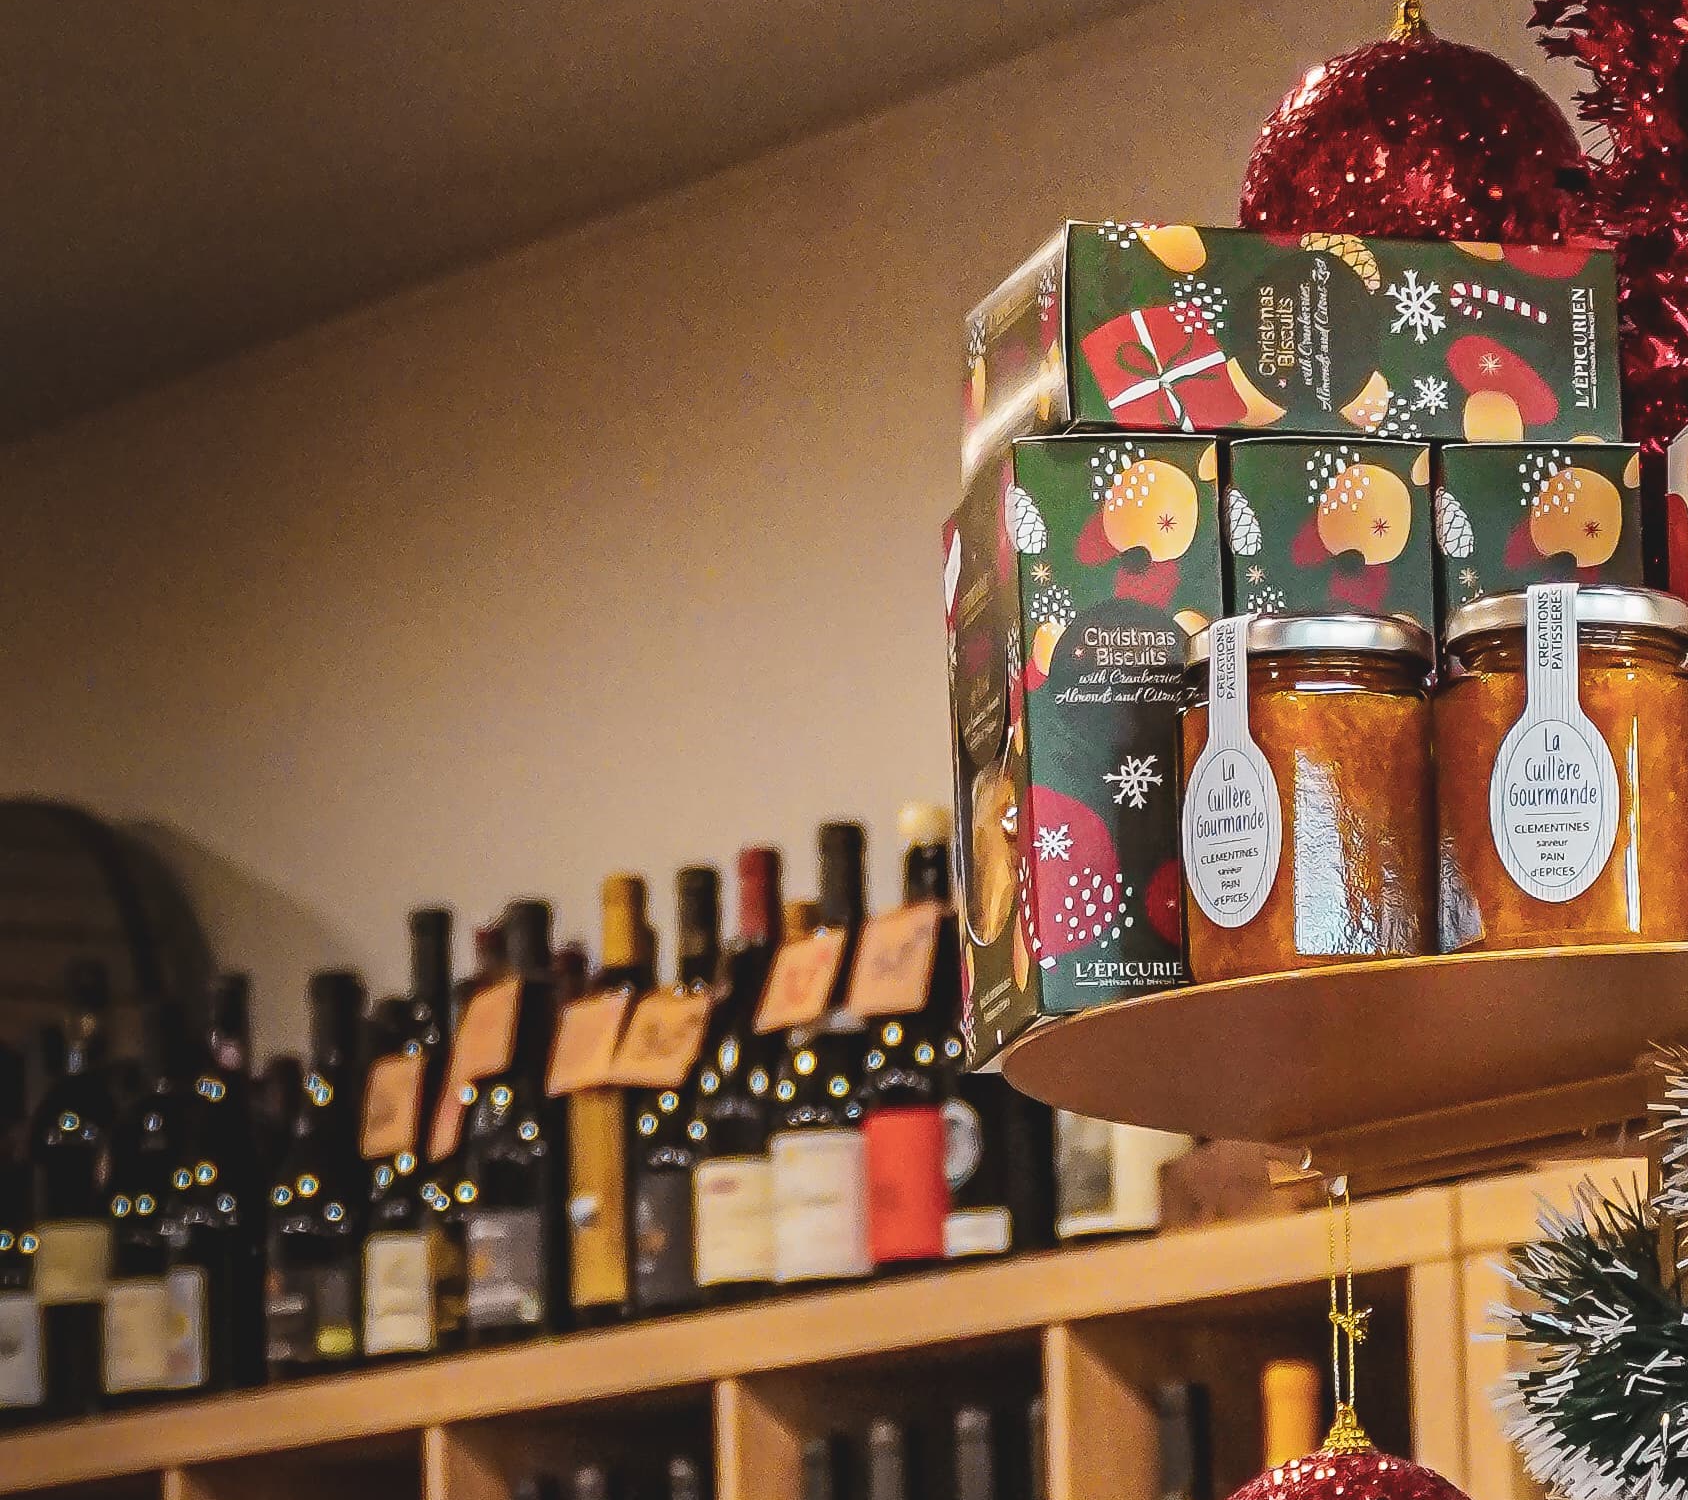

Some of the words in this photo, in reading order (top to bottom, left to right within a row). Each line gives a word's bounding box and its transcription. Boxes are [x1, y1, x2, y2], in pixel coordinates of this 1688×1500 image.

[1258, 286, 1276, 376] Christmas
[1276, 297, 1295, 368] Biscuits
[1572, 288, 1590, 409] L'ÉPICURIEN
[1084, 626, 1177, 647] Christmas
[1538, 591, 1549, 668] CREATIONS
[1551, 589, 1563, 670] PATISSIERES
[1097, 648, 1169, 667] Biscuits
[1216, 624, 1227, 699] CREATIONS
[1079, 671, 1107, 685] with
[1113, 687, 1143, 704] and
[1544, 727, 1561, 753] La
[1221, 757, 1236, 782] La
[1524, 756, 1581, 783] Cuillère
[1207, 788, 1252, 813] Cuillère
[1509, 783, 1598, 808] Gourmande
[1196, 810, 1265, 839] Gourmande
[1514, 821, 1590, 835] CLEMENTINES
[1200, 846, 1260, 865] CLEMENTINES
[1540, 852, 1565, 863] PAIN
[1221, 878, 1241, 891] PAIN
[1530, 867, 1576, 878] d'EPICES
[1074, 959, 1184, 978] L'ÉPICURIE
